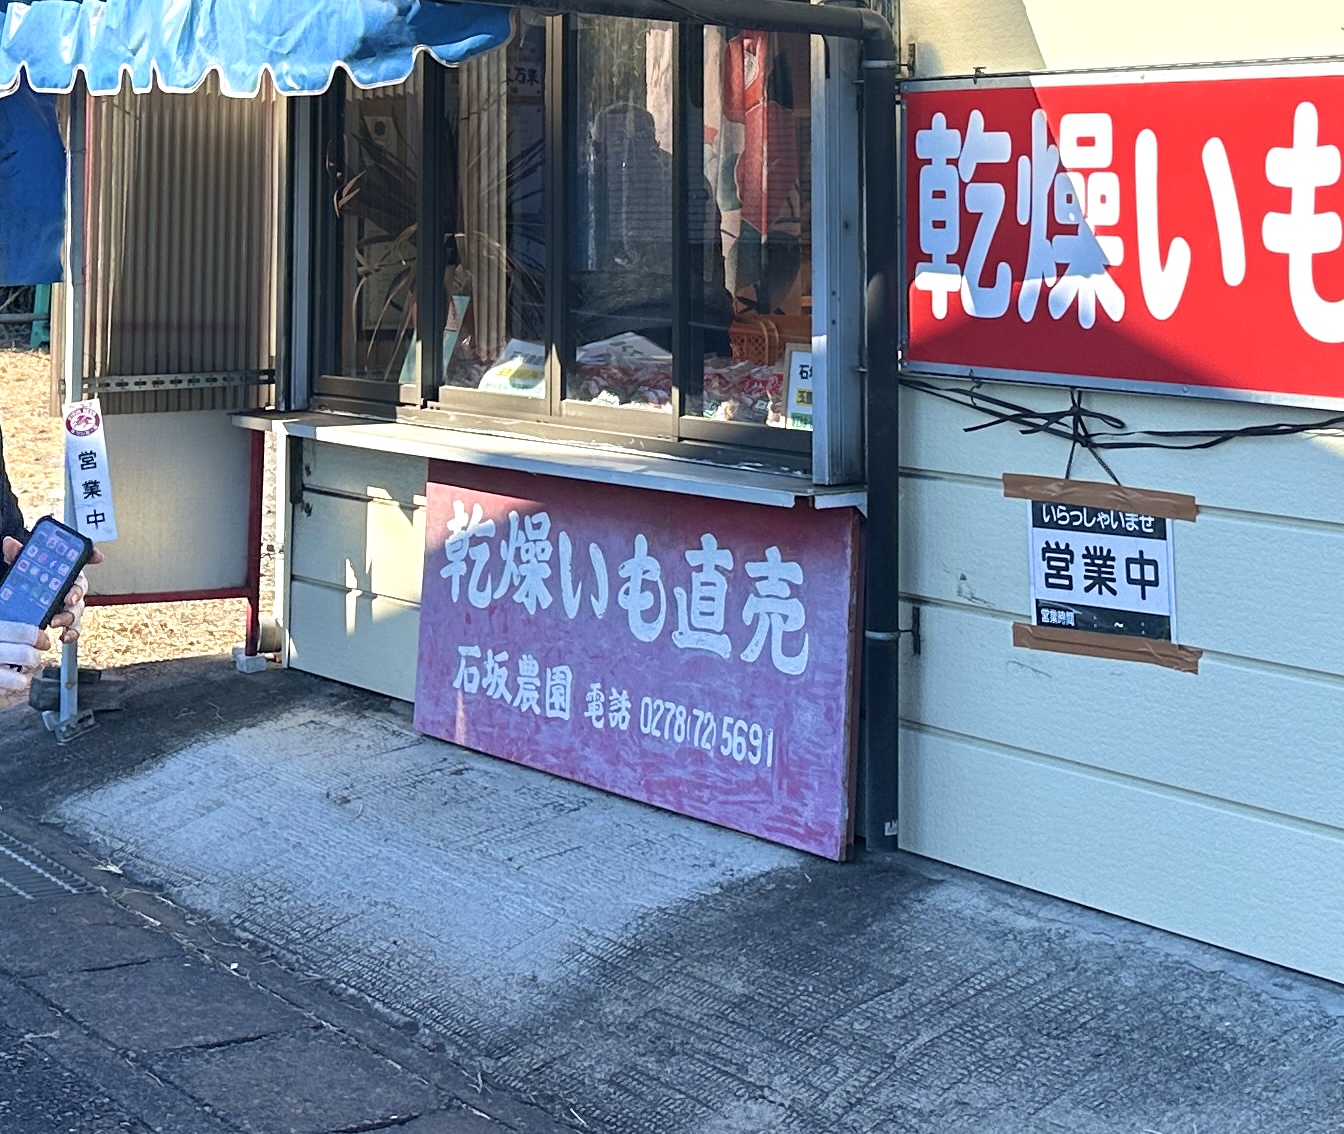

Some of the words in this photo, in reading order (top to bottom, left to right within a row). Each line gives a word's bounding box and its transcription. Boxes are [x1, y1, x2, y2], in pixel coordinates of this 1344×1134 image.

[78, 450, 106, 529] 営業中
[1042, 503, 1155, 533] いらっしゃいませ
[439, 499, 809, 675] 乾燥いも直売
[1041, 540, 1160, 601] 営業中
[1040, 608, 1076, 627] 営業時間
[453, 644, 572, 721] 石坂農園
[583, 683, 631, 732] 電話
